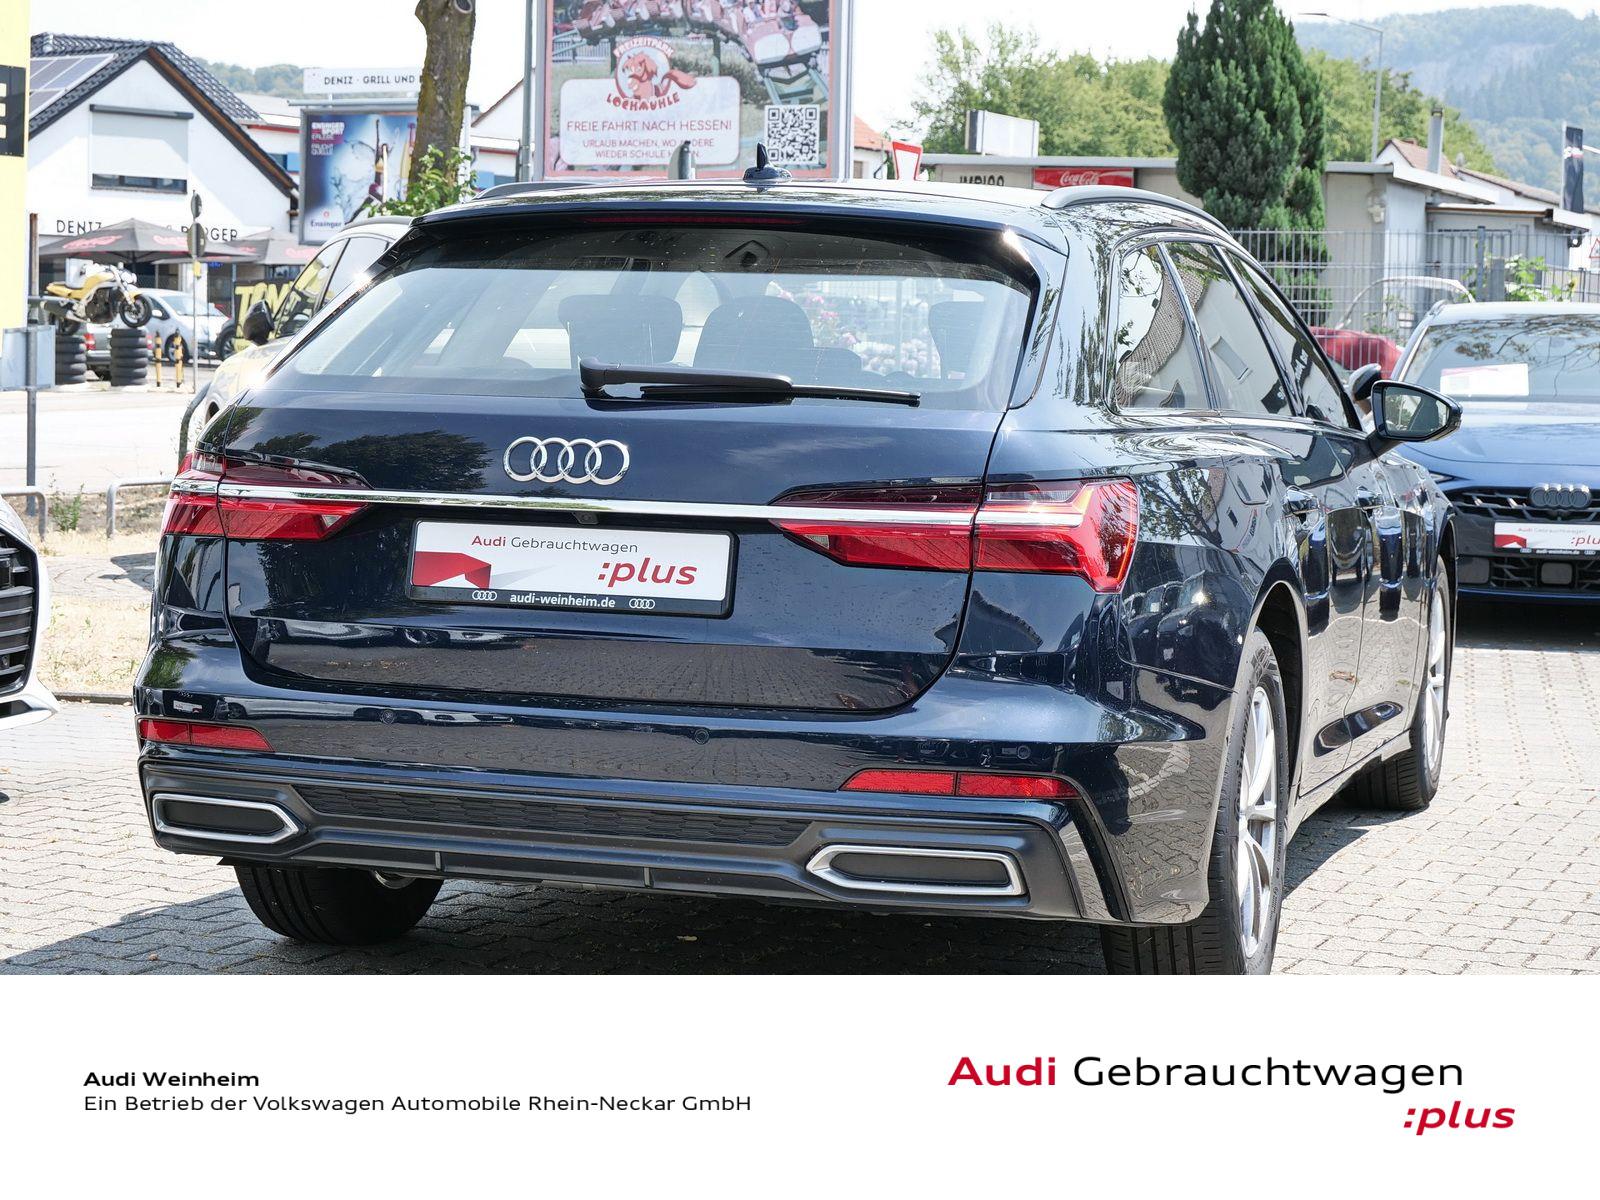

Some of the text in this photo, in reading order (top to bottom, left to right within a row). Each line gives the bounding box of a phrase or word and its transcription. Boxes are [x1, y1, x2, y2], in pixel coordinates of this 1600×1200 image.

[324, 76, 353, 85] DENIZ
[363, 76, 390, 84] GRILL
[395, 75, 415, 83] UND
[566, 120, 732, 132] FREIE FAHRT NACH HESSEN!
[582, 139, 617, 147] URLAUB
[662, 138, 676, 147] WO
[595, 150, 628, 158] WIEDER
[629, 149, 666, 158] SCHULE
[181, 225, 238, 241] BGER
[471, 535, 638, 555] Audi Gebrauchtwagen
[597, 557, 697, 588] :plus
[510, 592, 616, 608] audi-weinheim.de
